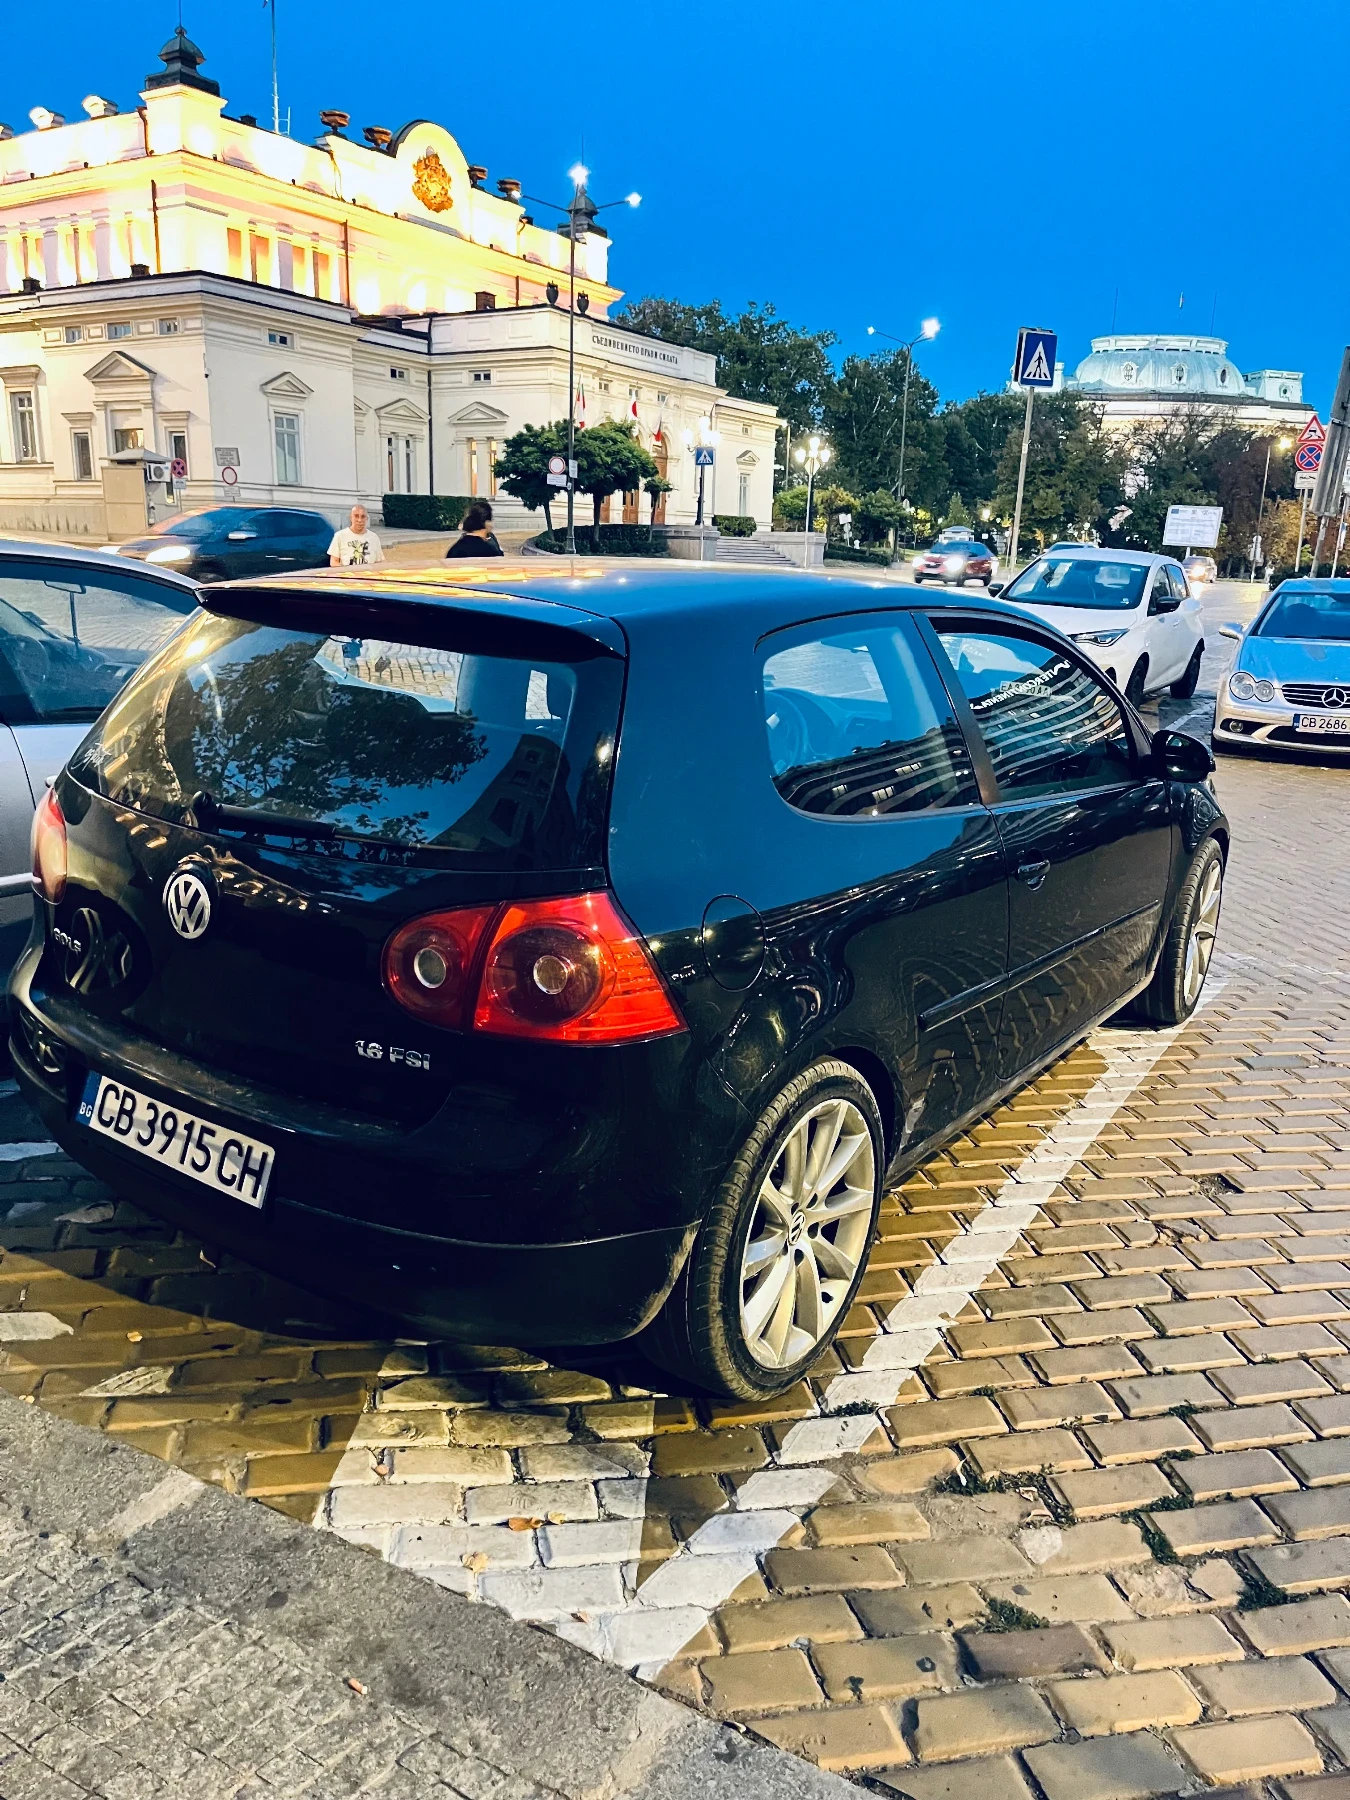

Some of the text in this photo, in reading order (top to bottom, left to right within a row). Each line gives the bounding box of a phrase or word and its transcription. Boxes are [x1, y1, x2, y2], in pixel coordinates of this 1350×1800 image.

[592, 335, 678, 364] СЪЕДИНЕНИЕТО ПРАВИ СИЛАТА
[1301, 717, 1317, 728] CB
[1318, 718, 1348, 729] 2686
[389, 1046, 431, 1071] FSI
[79, 1101, 93, 1118] BG
[97, 1083, 269, 1199] CB 3915 CH
